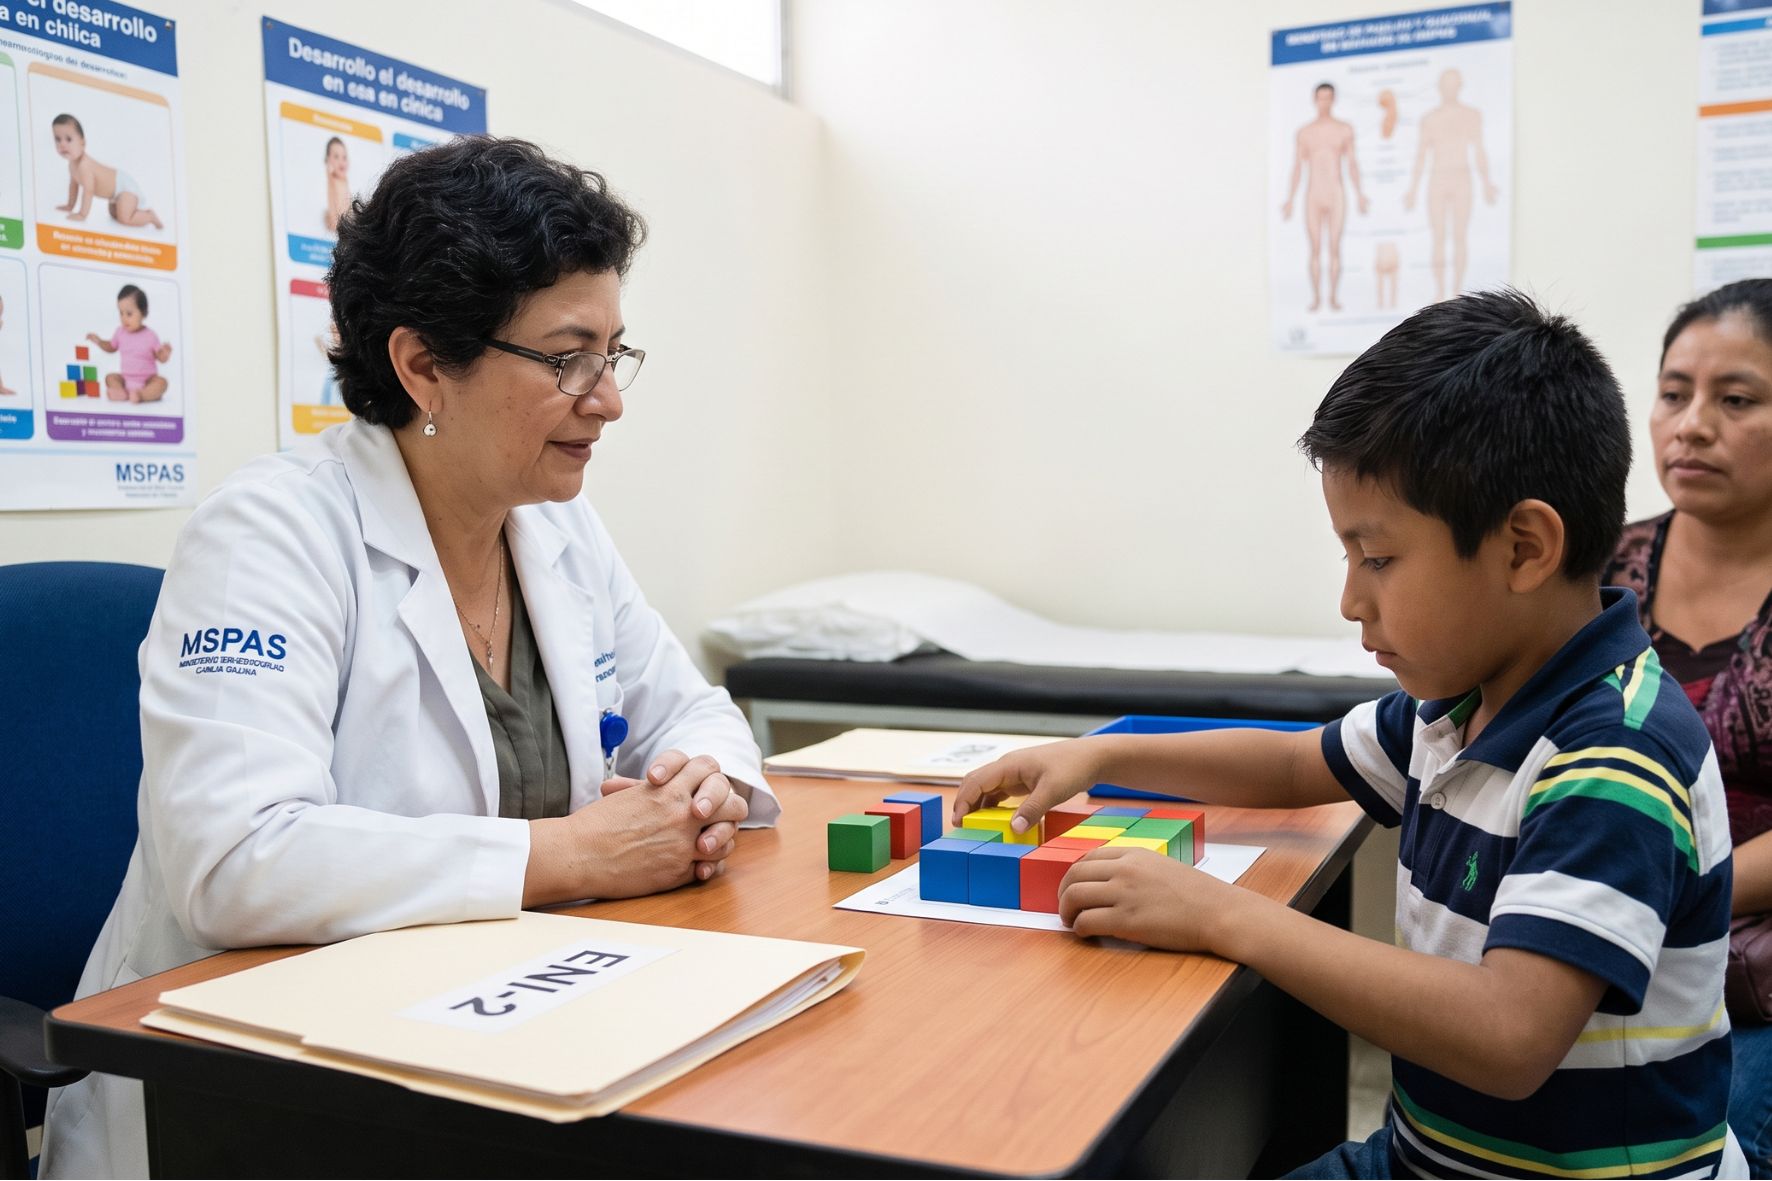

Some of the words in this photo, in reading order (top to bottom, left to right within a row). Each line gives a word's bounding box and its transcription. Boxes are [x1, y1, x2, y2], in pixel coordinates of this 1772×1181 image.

[15, 11, 40, 30] en
[52, 0, 157, 43] desarrollo
[288, 36, 376, 81] Desarrollo
[378, 67, 394, 87] el
[396, 71, 470, 111] desarrollo
[322, 74, 345, 94] en
[116, 463, 184, 482] MSPAS
[181, 628, 287, 660] MSPAS
[448, 950, 631, 1016] ENI-2
